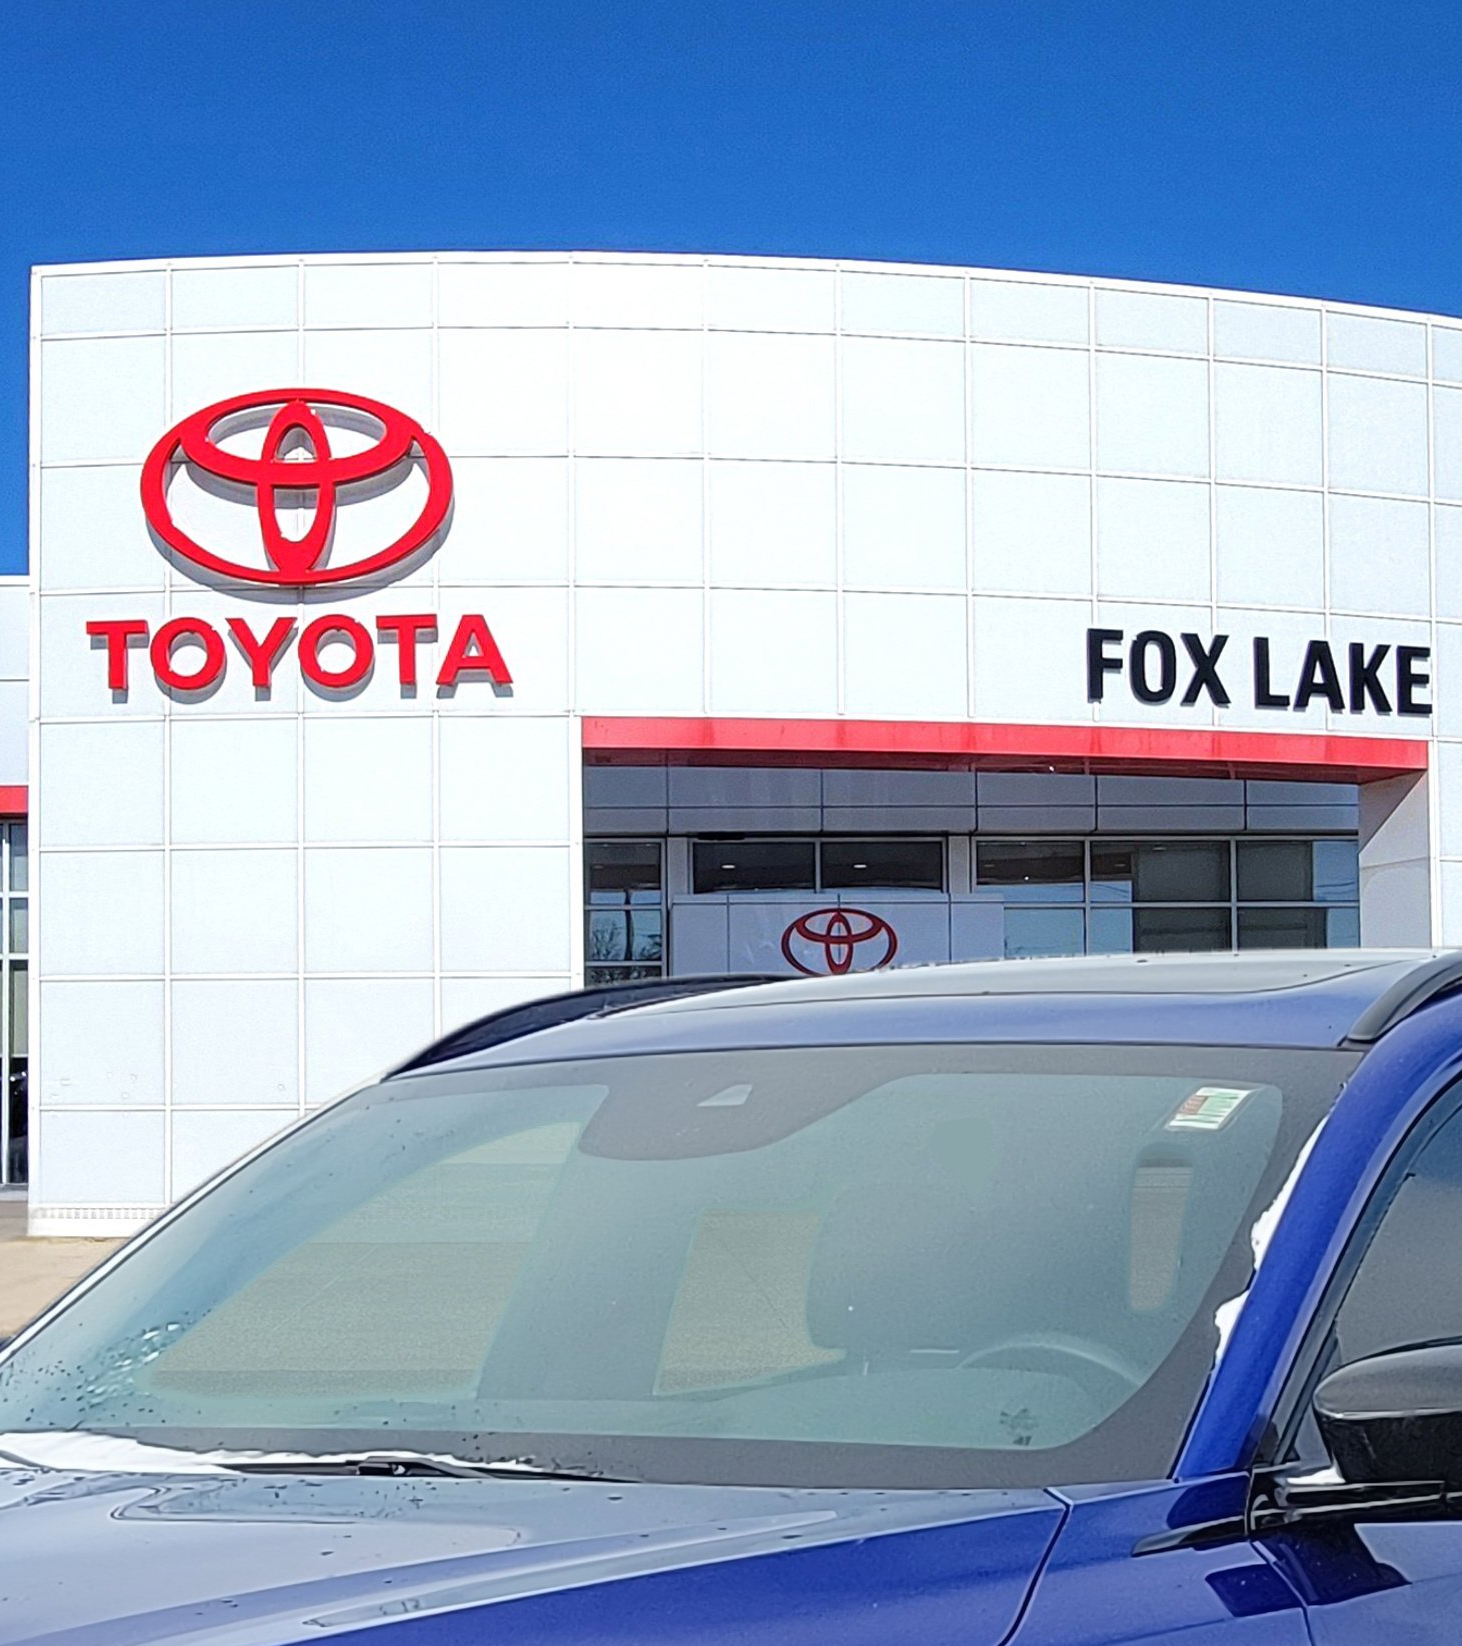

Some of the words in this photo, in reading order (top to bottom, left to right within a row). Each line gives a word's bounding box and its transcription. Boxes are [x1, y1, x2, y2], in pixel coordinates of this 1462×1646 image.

[86, 613, 514, 694] TOYOTA
[1087, 627, 1231, 706] FOX
[1253, 636, 1433, 716] LAKE
